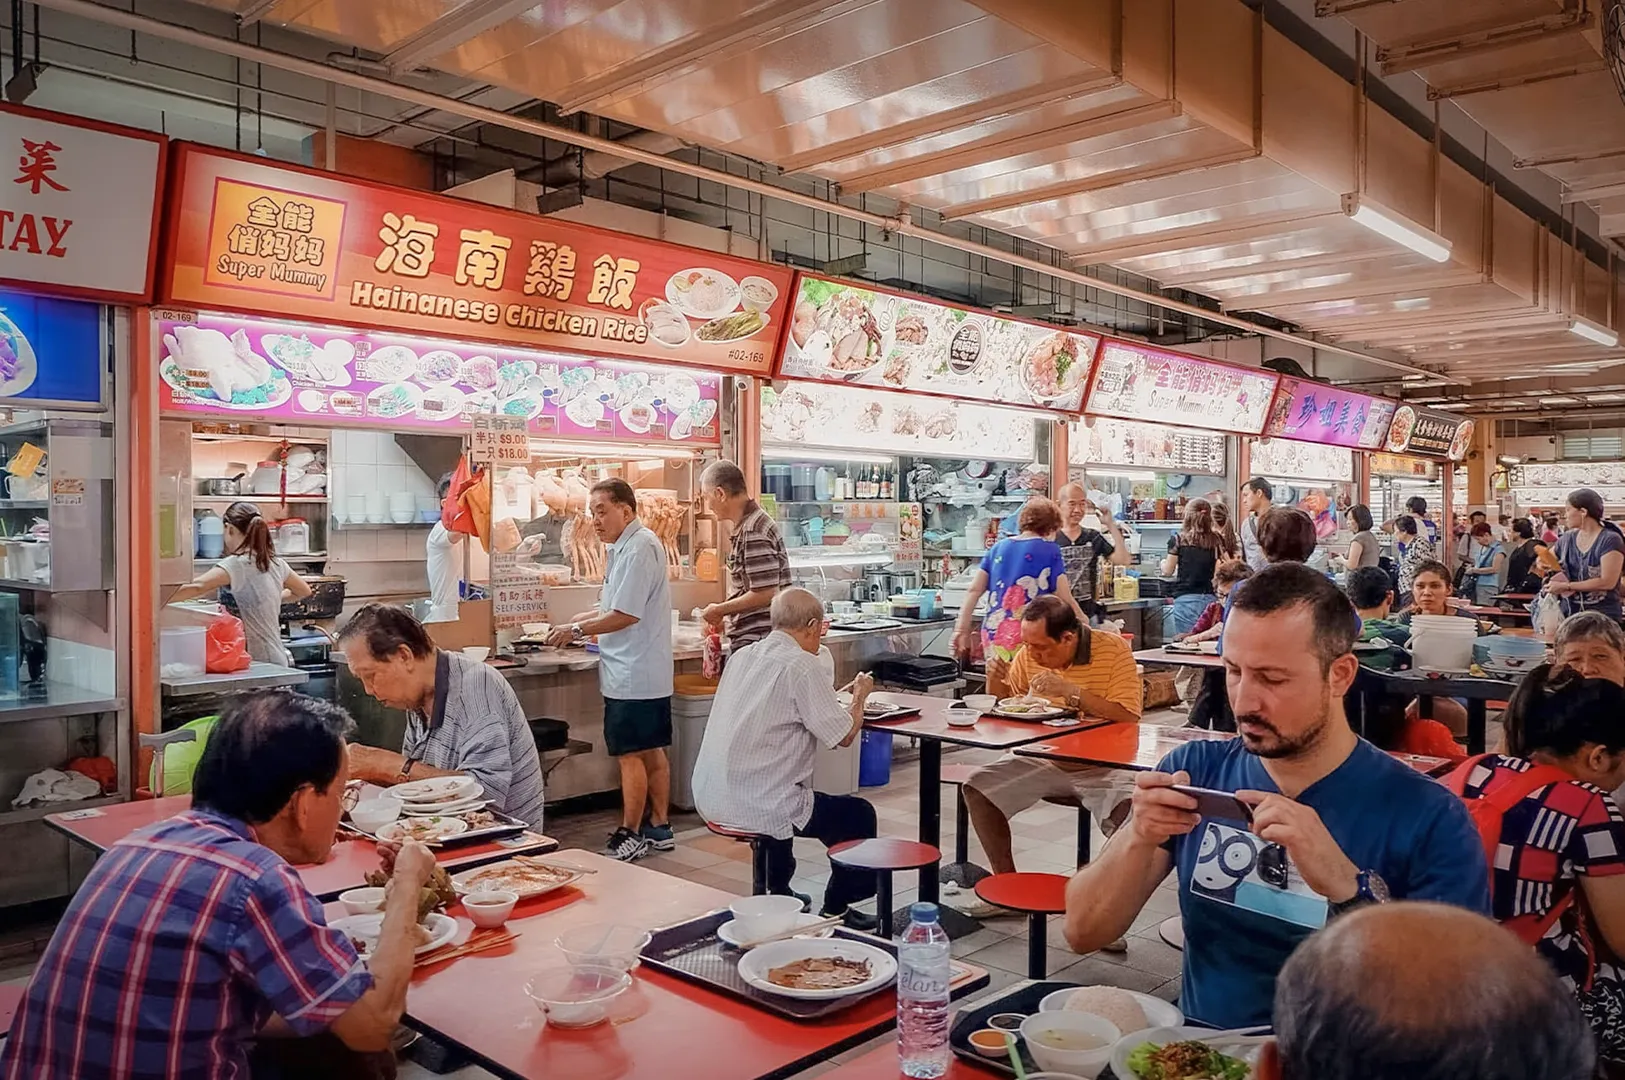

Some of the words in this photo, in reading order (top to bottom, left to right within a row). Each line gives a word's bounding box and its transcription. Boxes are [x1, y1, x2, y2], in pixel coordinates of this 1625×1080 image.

[13, 137, 72, 194] 菜
[247, 196, 315, 233] 全能
[227, 223, 325, 267] 俏妈妈
[217, 253, 265, 280] Super
[270, 261, 327, 292] Mummy
[162, 312, 192, 322] 02-169
[350, 281, 500, 324] Hainanese
[504, 304, 599, 338] Chicken
[600, 318, 649, 344] Rice
[728, 349, 764, 363] #02-169
[1148, 390, 1174, 410] Super
[475, 431, 496, 444] 半只
[500, 434, 527, 444] $9.00
[476, 446, 495, 459] 一只
[498, 448, 528, 459] $18.00
[495, 602, 548, 613] SELF-SERVICE
